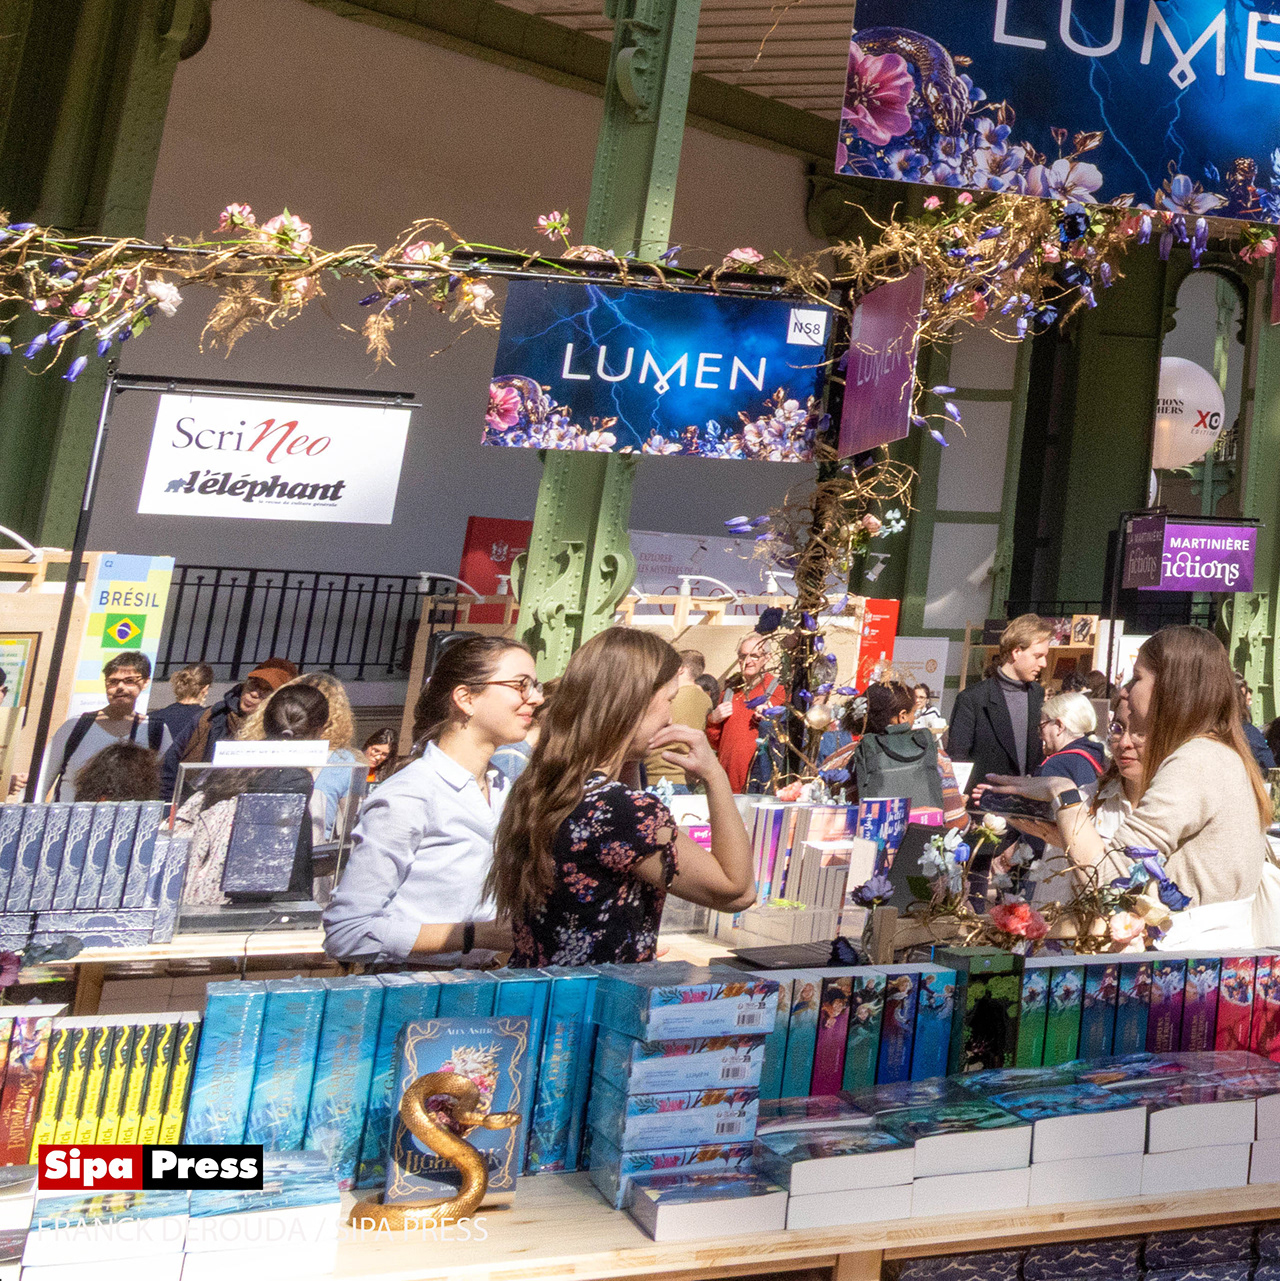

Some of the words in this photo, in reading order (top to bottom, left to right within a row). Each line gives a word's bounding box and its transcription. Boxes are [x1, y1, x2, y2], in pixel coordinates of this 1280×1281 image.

[793, 322, 821, 336] NS8
[561, 343, 767, 395] LUMEN
[183, 469, 346, 503] l'éléphant
[1170, 537, 1250, 551] MARTINIÈRE
[99, 587, 160, 608] BRÉSIL
